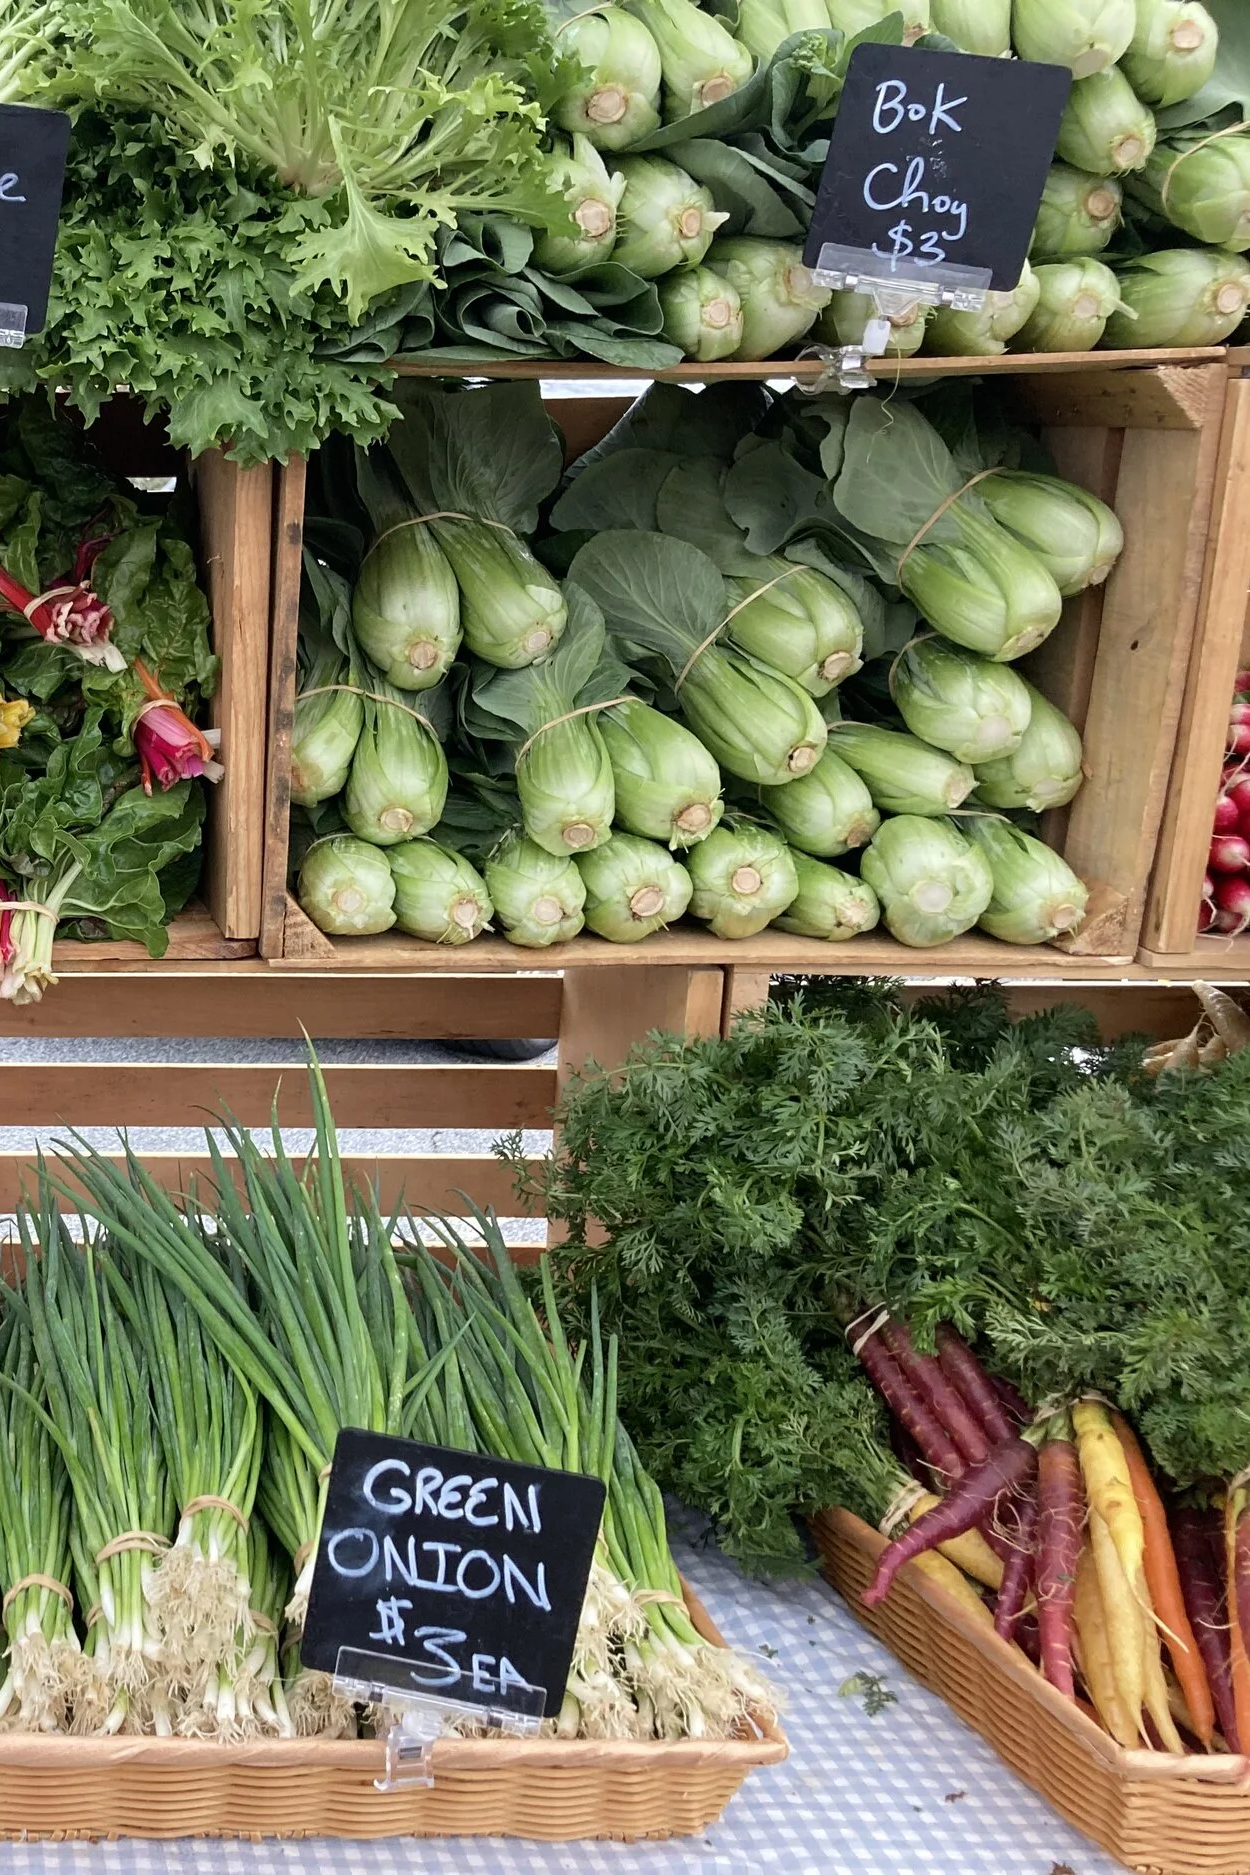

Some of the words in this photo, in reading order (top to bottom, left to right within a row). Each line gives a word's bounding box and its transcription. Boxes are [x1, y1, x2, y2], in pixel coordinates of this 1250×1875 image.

[863, 156, 967, 241] Choy
[871, 219, 946, 272] $3
[363, 1458, 541, 1534] GREEN
[327, 1527, 551, 1611] ONION
